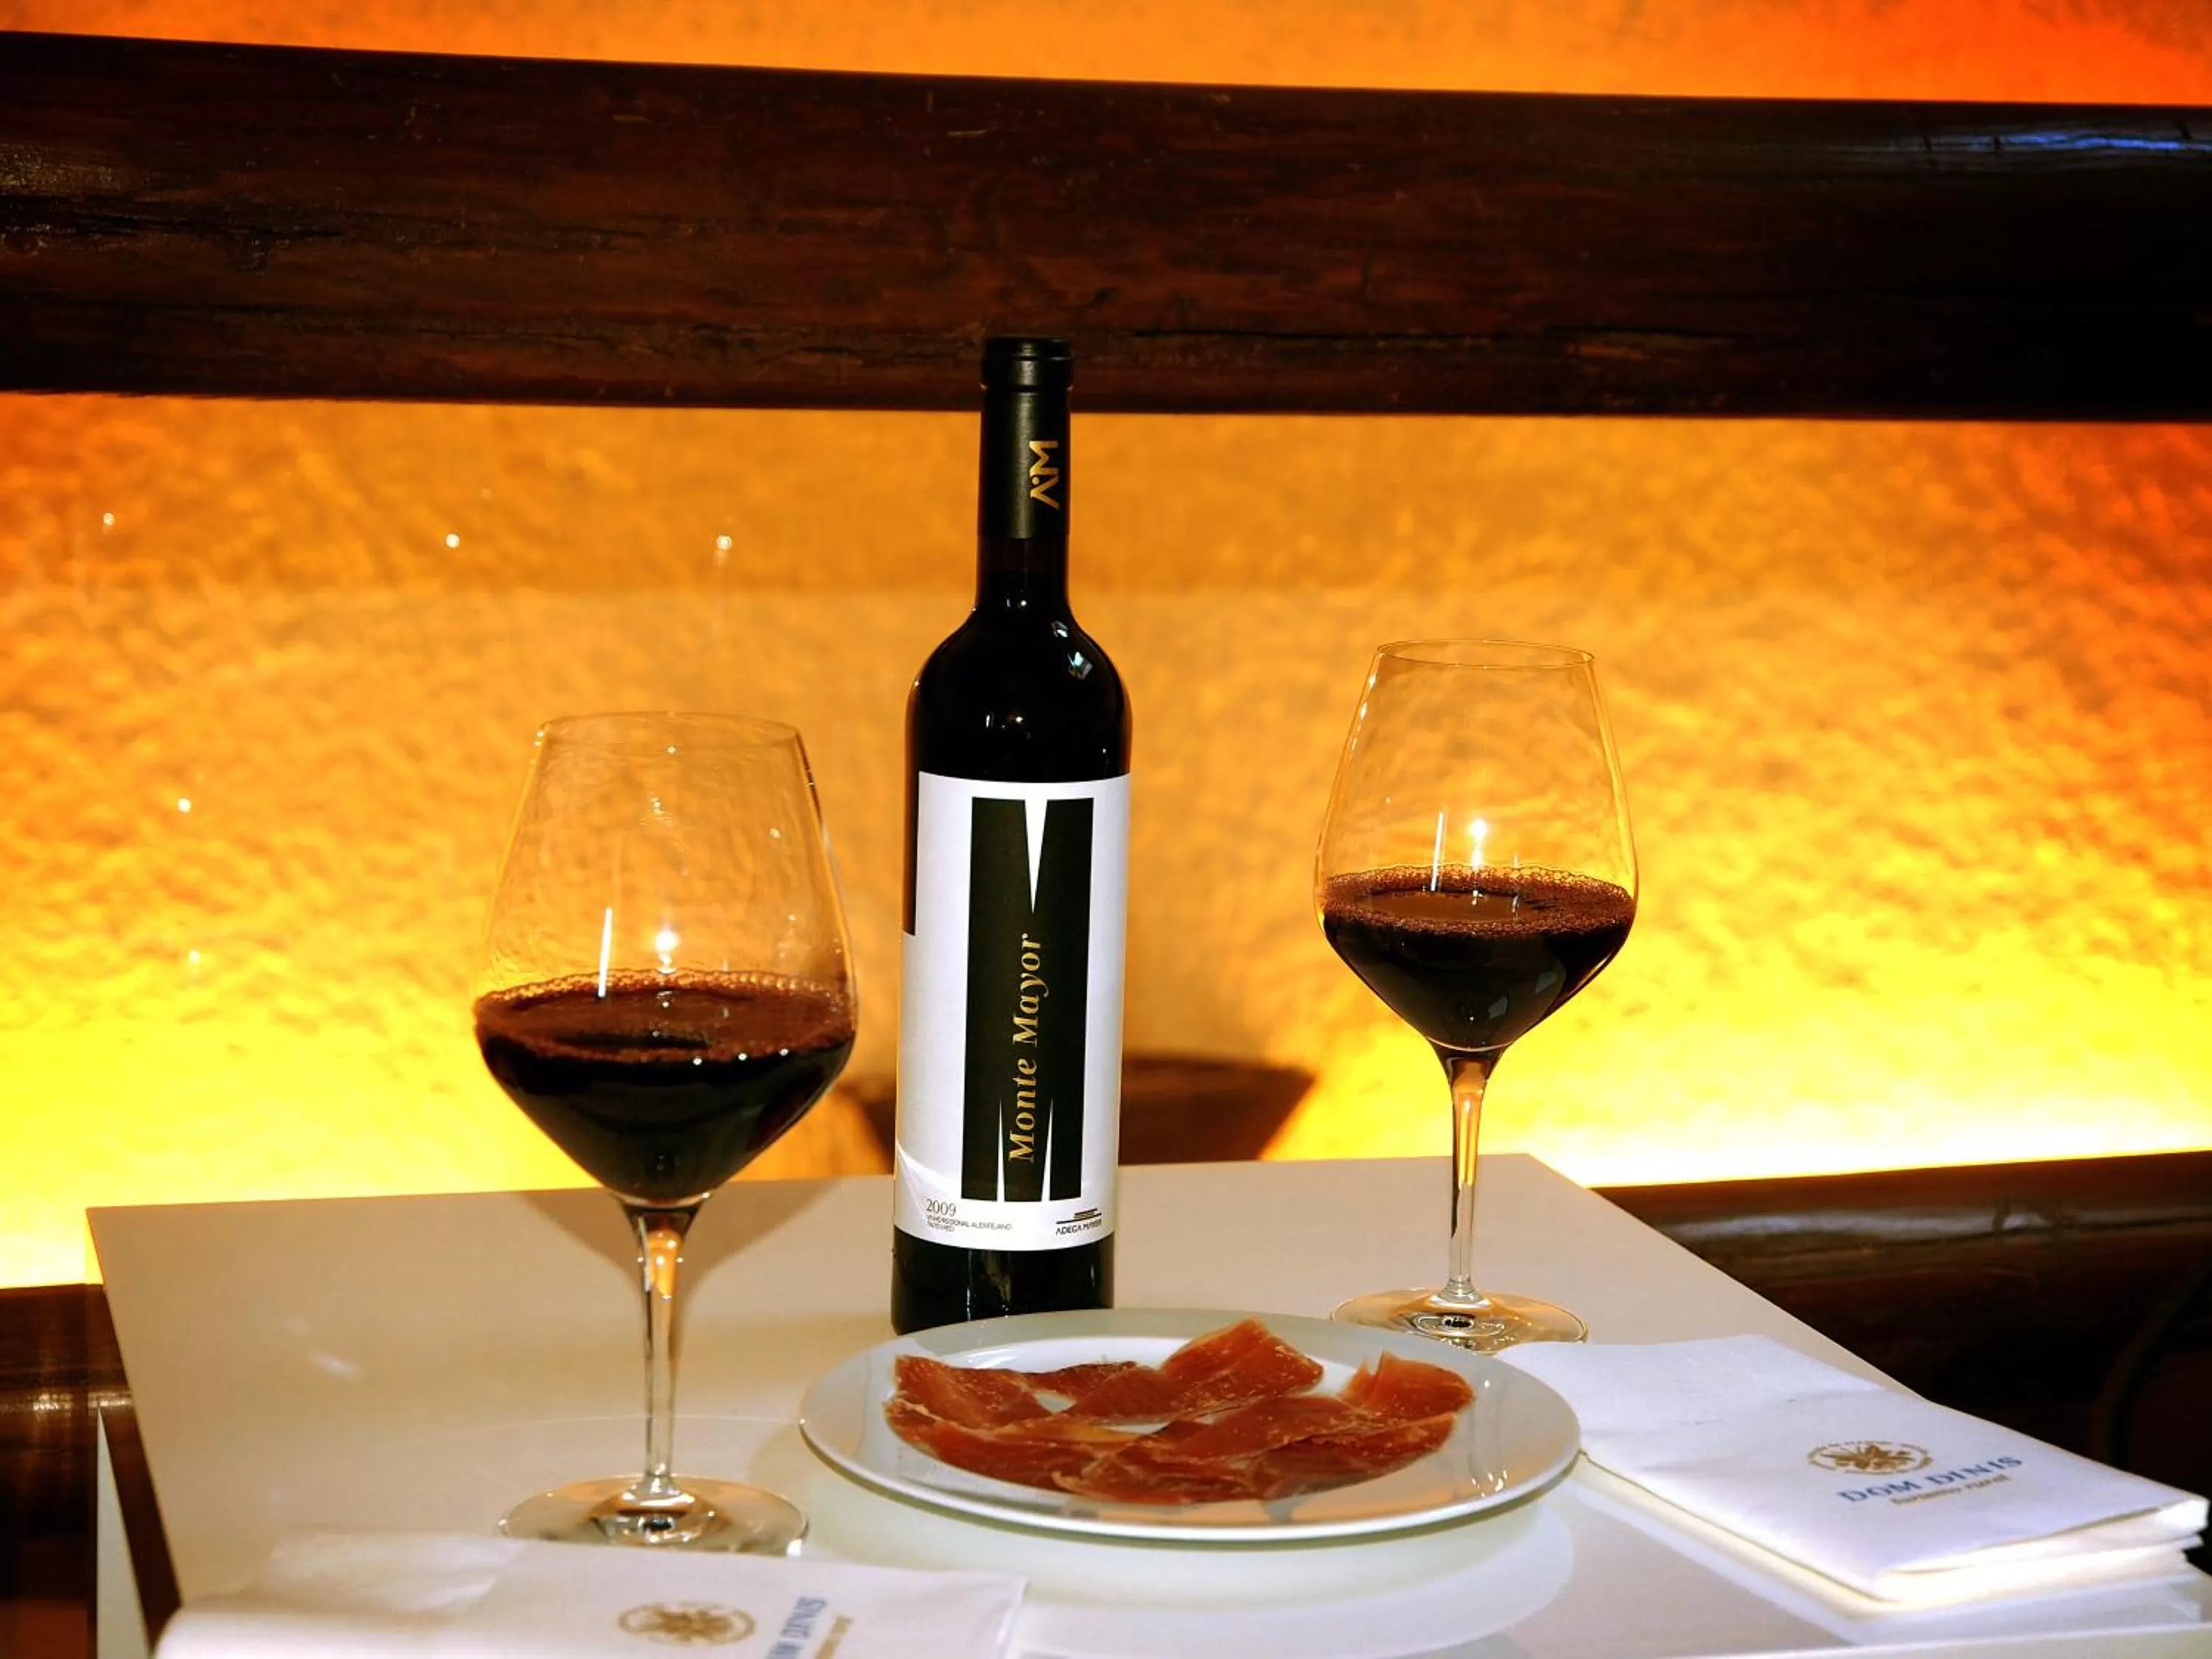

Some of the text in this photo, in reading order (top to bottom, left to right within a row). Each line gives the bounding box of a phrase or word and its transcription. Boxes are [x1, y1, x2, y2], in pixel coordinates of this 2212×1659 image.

[1009, 932, 1049, 1164] Monte Mayor
[925, 1197, 957, 1217] 2009
[1055, 1224, 1082, 1236] ADEGA
[1837, 1479, 1921, 1503] DOM
[1925, 1455, 2024, 1486] DINIS
